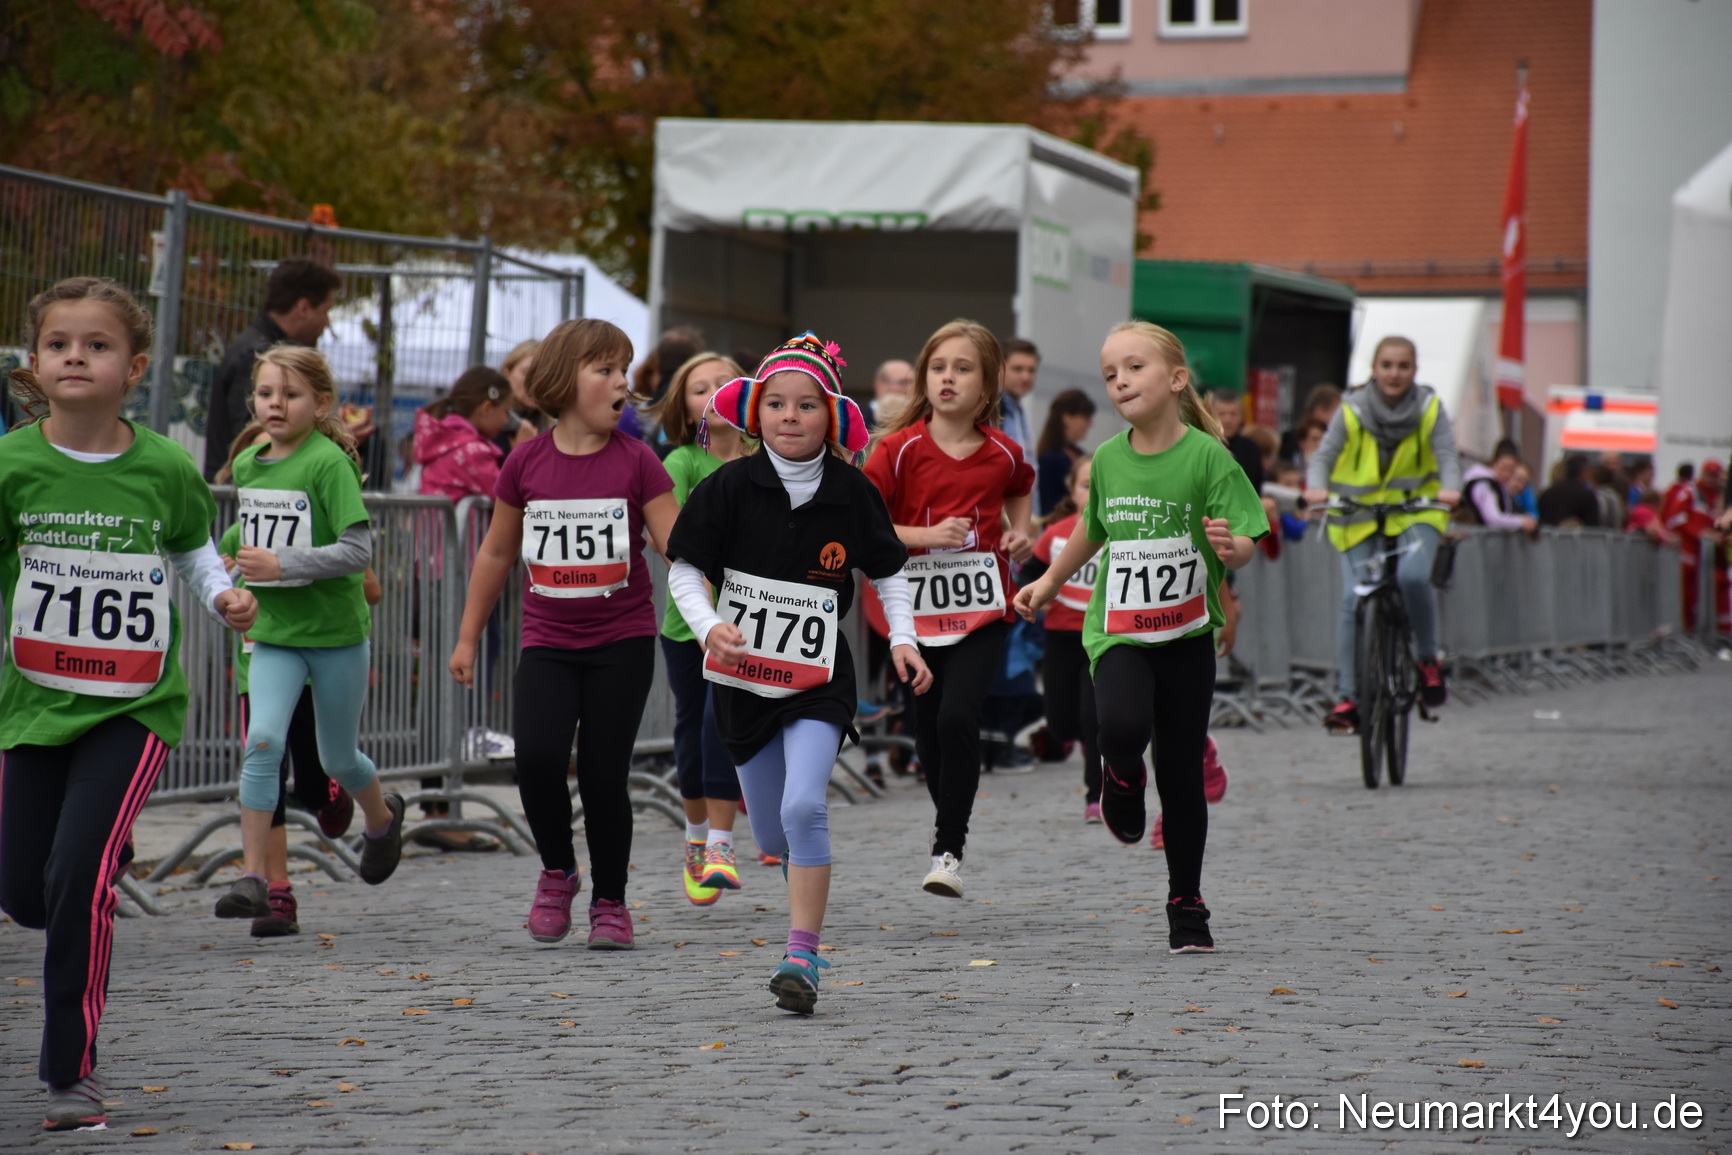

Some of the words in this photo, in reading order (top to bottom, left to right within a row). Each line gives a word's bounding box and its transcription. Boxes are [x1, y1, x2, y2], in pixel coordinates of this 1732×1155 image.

[253, 500, 291, 510] Neumarkt
[557, 510, 609, 519] Neumarkt
[19, 511, 124, 527] Neumarkter
[241, 513, 300, 548] 7177
[533, 524, 615, 560] 7151
[904, 562, 932, 572] ARTL
[933, 559, 981, 570] Neumarkt
[1111, 552, 1137, 561] PARTL
[1138, 548, 1189, 561] Neumarkt
[24, 556, 66, 577] PARTL
[69, 564, 144, 582] Neumarkt
[553, 570, 598, 585] Celina
[907, 571, 995, 611] 7099
[1116, 559, 1198, 604] 7127
[724, 580, 756, 599] PARTL
[759, 590, 818, 610] Neumarkt
[31, 581, 155, 643] 7165
[1134, 611, 1184, 631] Sophie
[728, 600, 826, 659] 7179
[939, 618, 967, 632] Lisa
[55, 651, 117, 676] Emma
[736, 660, 793, 684] Helene
